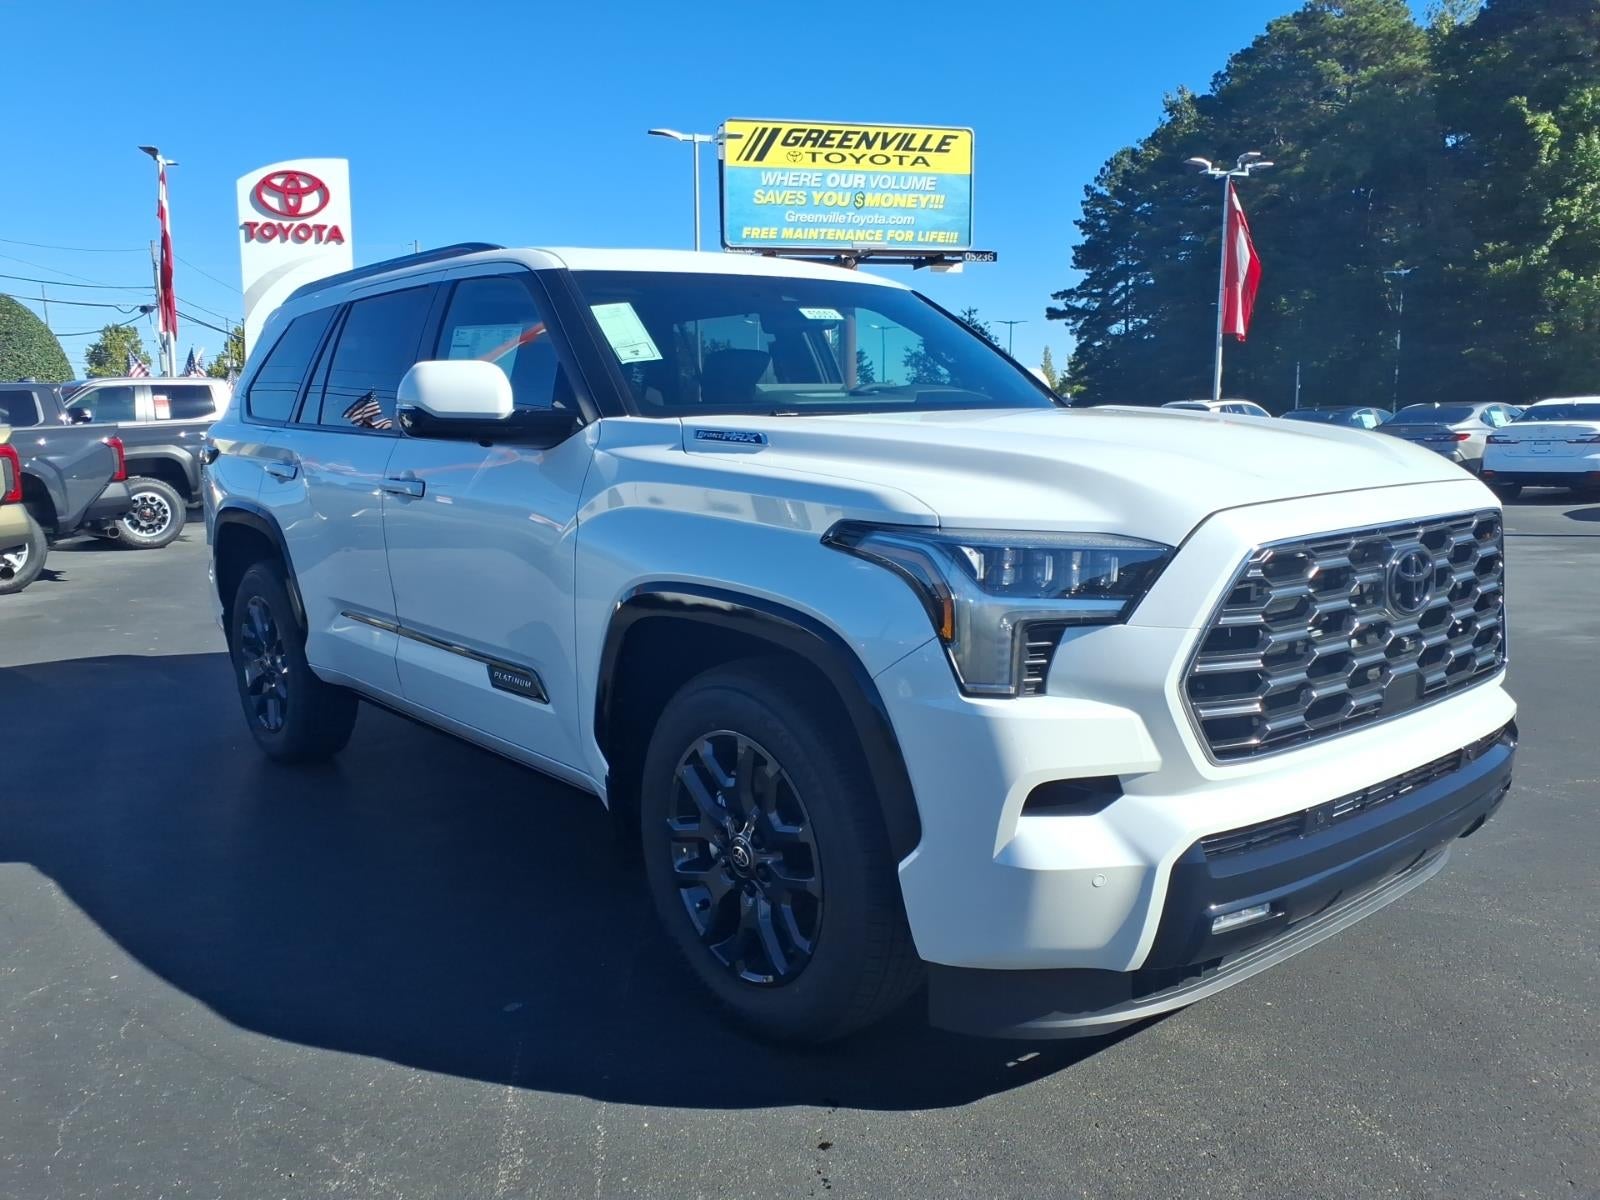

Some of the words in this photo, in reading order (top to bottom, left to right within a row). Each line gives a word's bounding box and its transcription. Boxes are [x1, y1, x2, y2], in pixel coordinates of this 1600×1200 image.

[780, 127, 959, 154] GREENVILLE
[805, 151, 931, 167] TOYOTA
[760, 171, 823, 188] WHERE
[826, 173, 866, 189] OUR
[869, 175, 937, 191] VOLUME
[753, 189, 808, 206] SAVES
[811, 191, 852, 207] YOU
[785, 211, 916, 226] GreenvilleToyota.com
[241, 221, 345, 244] TOYOTA
[742, 227, 778, 240] FREE
[780, 228, 882, 242] MAINTENANCE
[886, 230, 914, 242] FOR
[917, 231, 959, 244] LIFE!!!
[965, 252, 994, 262] 05236
[493, 671, 532, 688] PLATINUM
